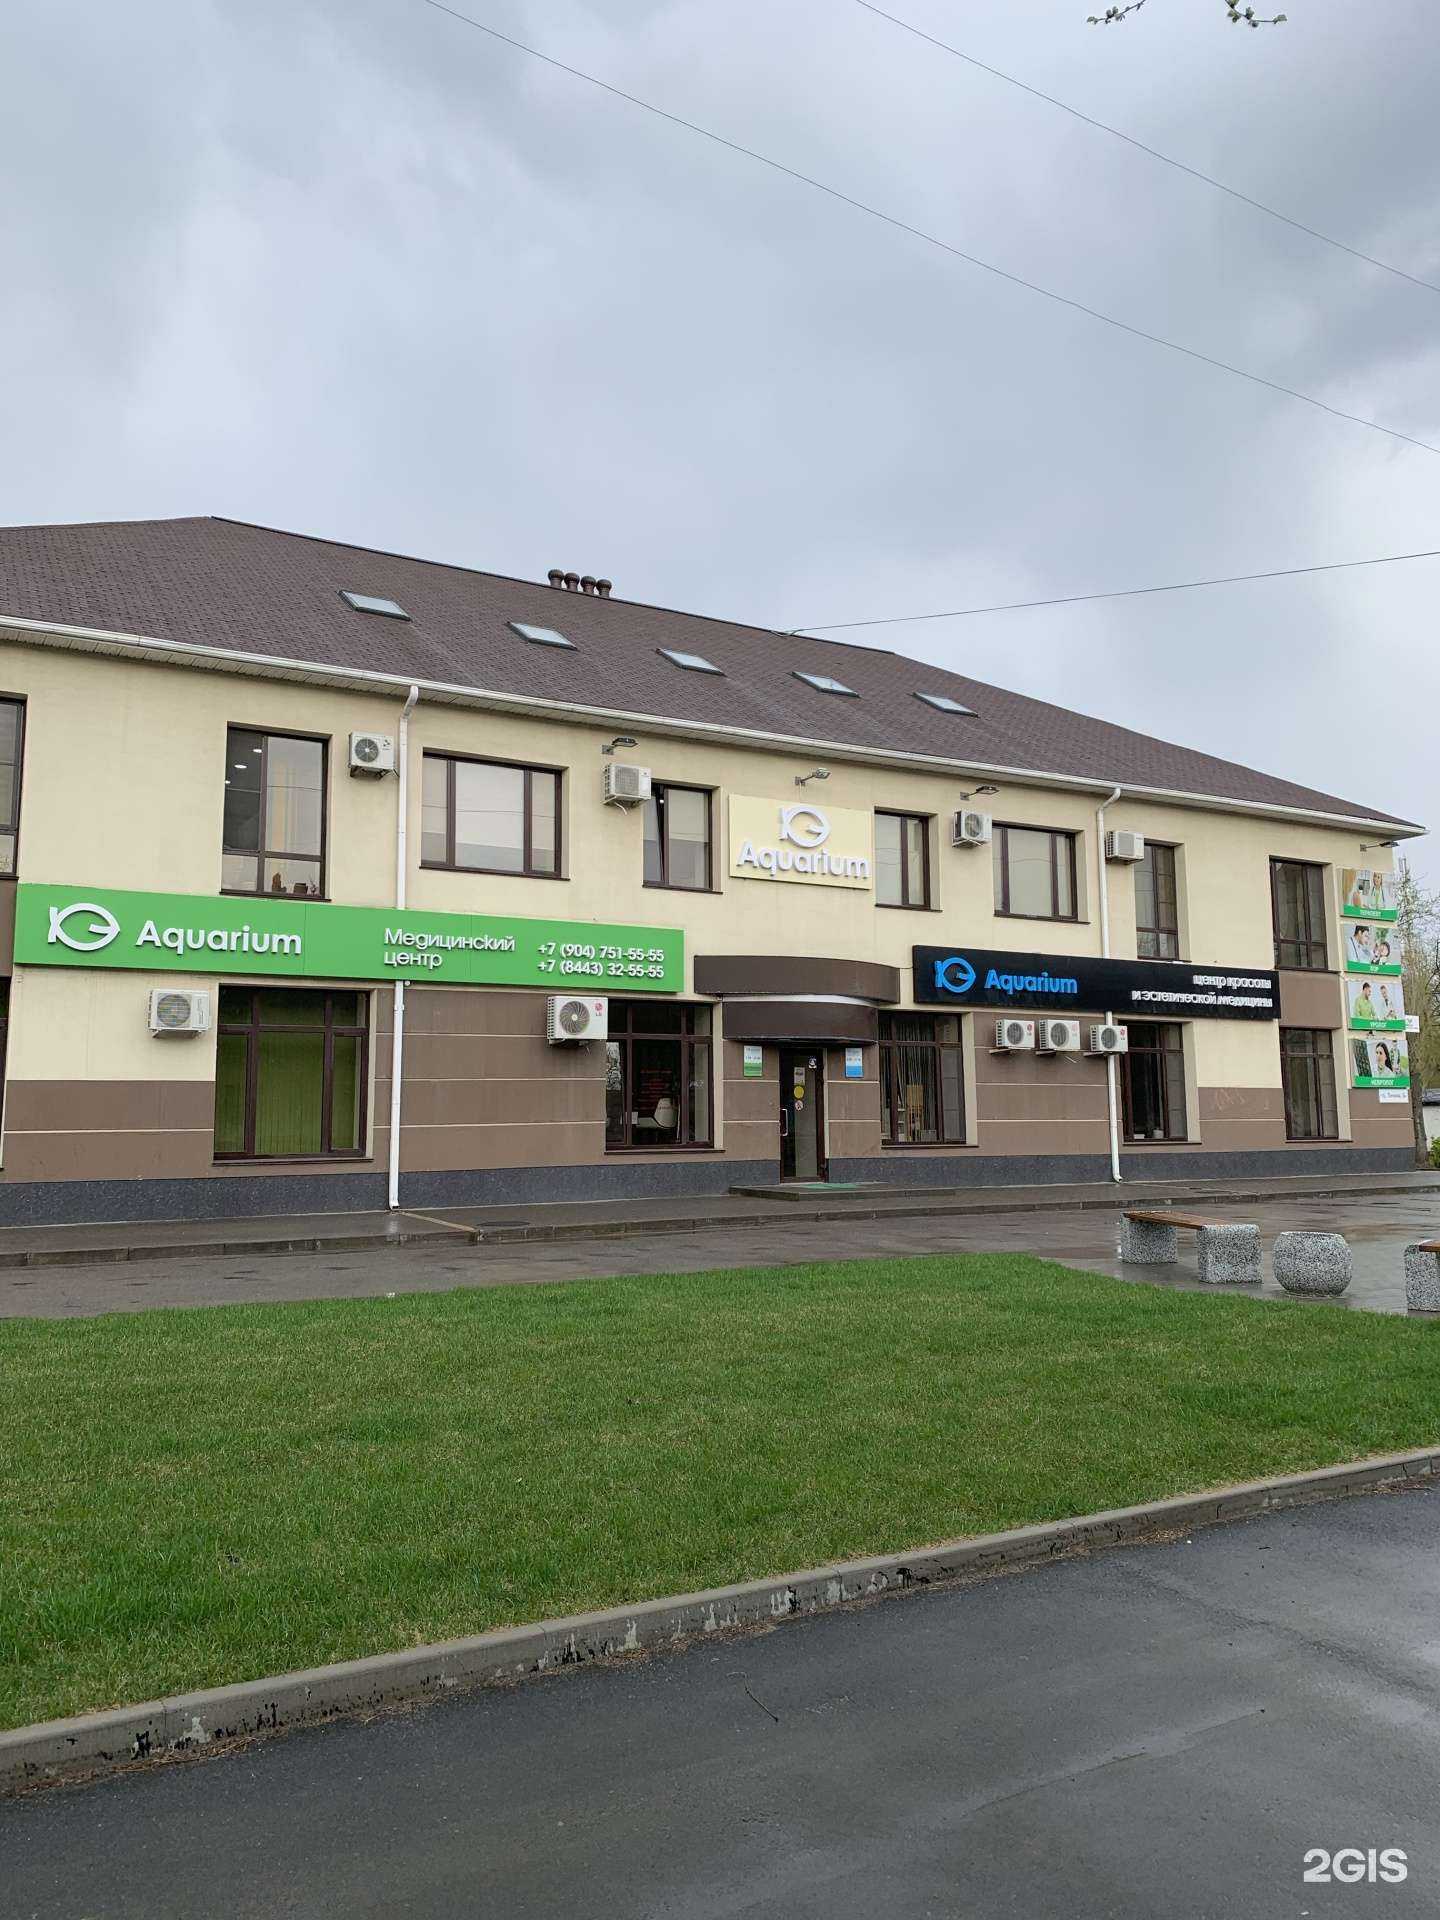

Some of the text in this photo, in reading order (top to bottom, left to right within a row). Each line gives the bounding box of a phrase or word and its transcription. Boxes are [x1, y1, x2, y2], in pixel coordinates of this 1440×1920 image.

[736, 840, 869, 879] Aquarium
[136, 920, 302, 955] Aquarium
[384, 927, 516, 951] Медицинский
[384, 951, 443, 970] центр
[538, 943, 664, 962] +7 (904) 751-55-55
[537, 960, 664, 978] +7 (8443) 32-55-55
[984, 969, 1078, 995] Aquarium
[1193, 975, 1272, 989] центр красоты
[1131, 990, 1273, 1008] и эстетической медицины
